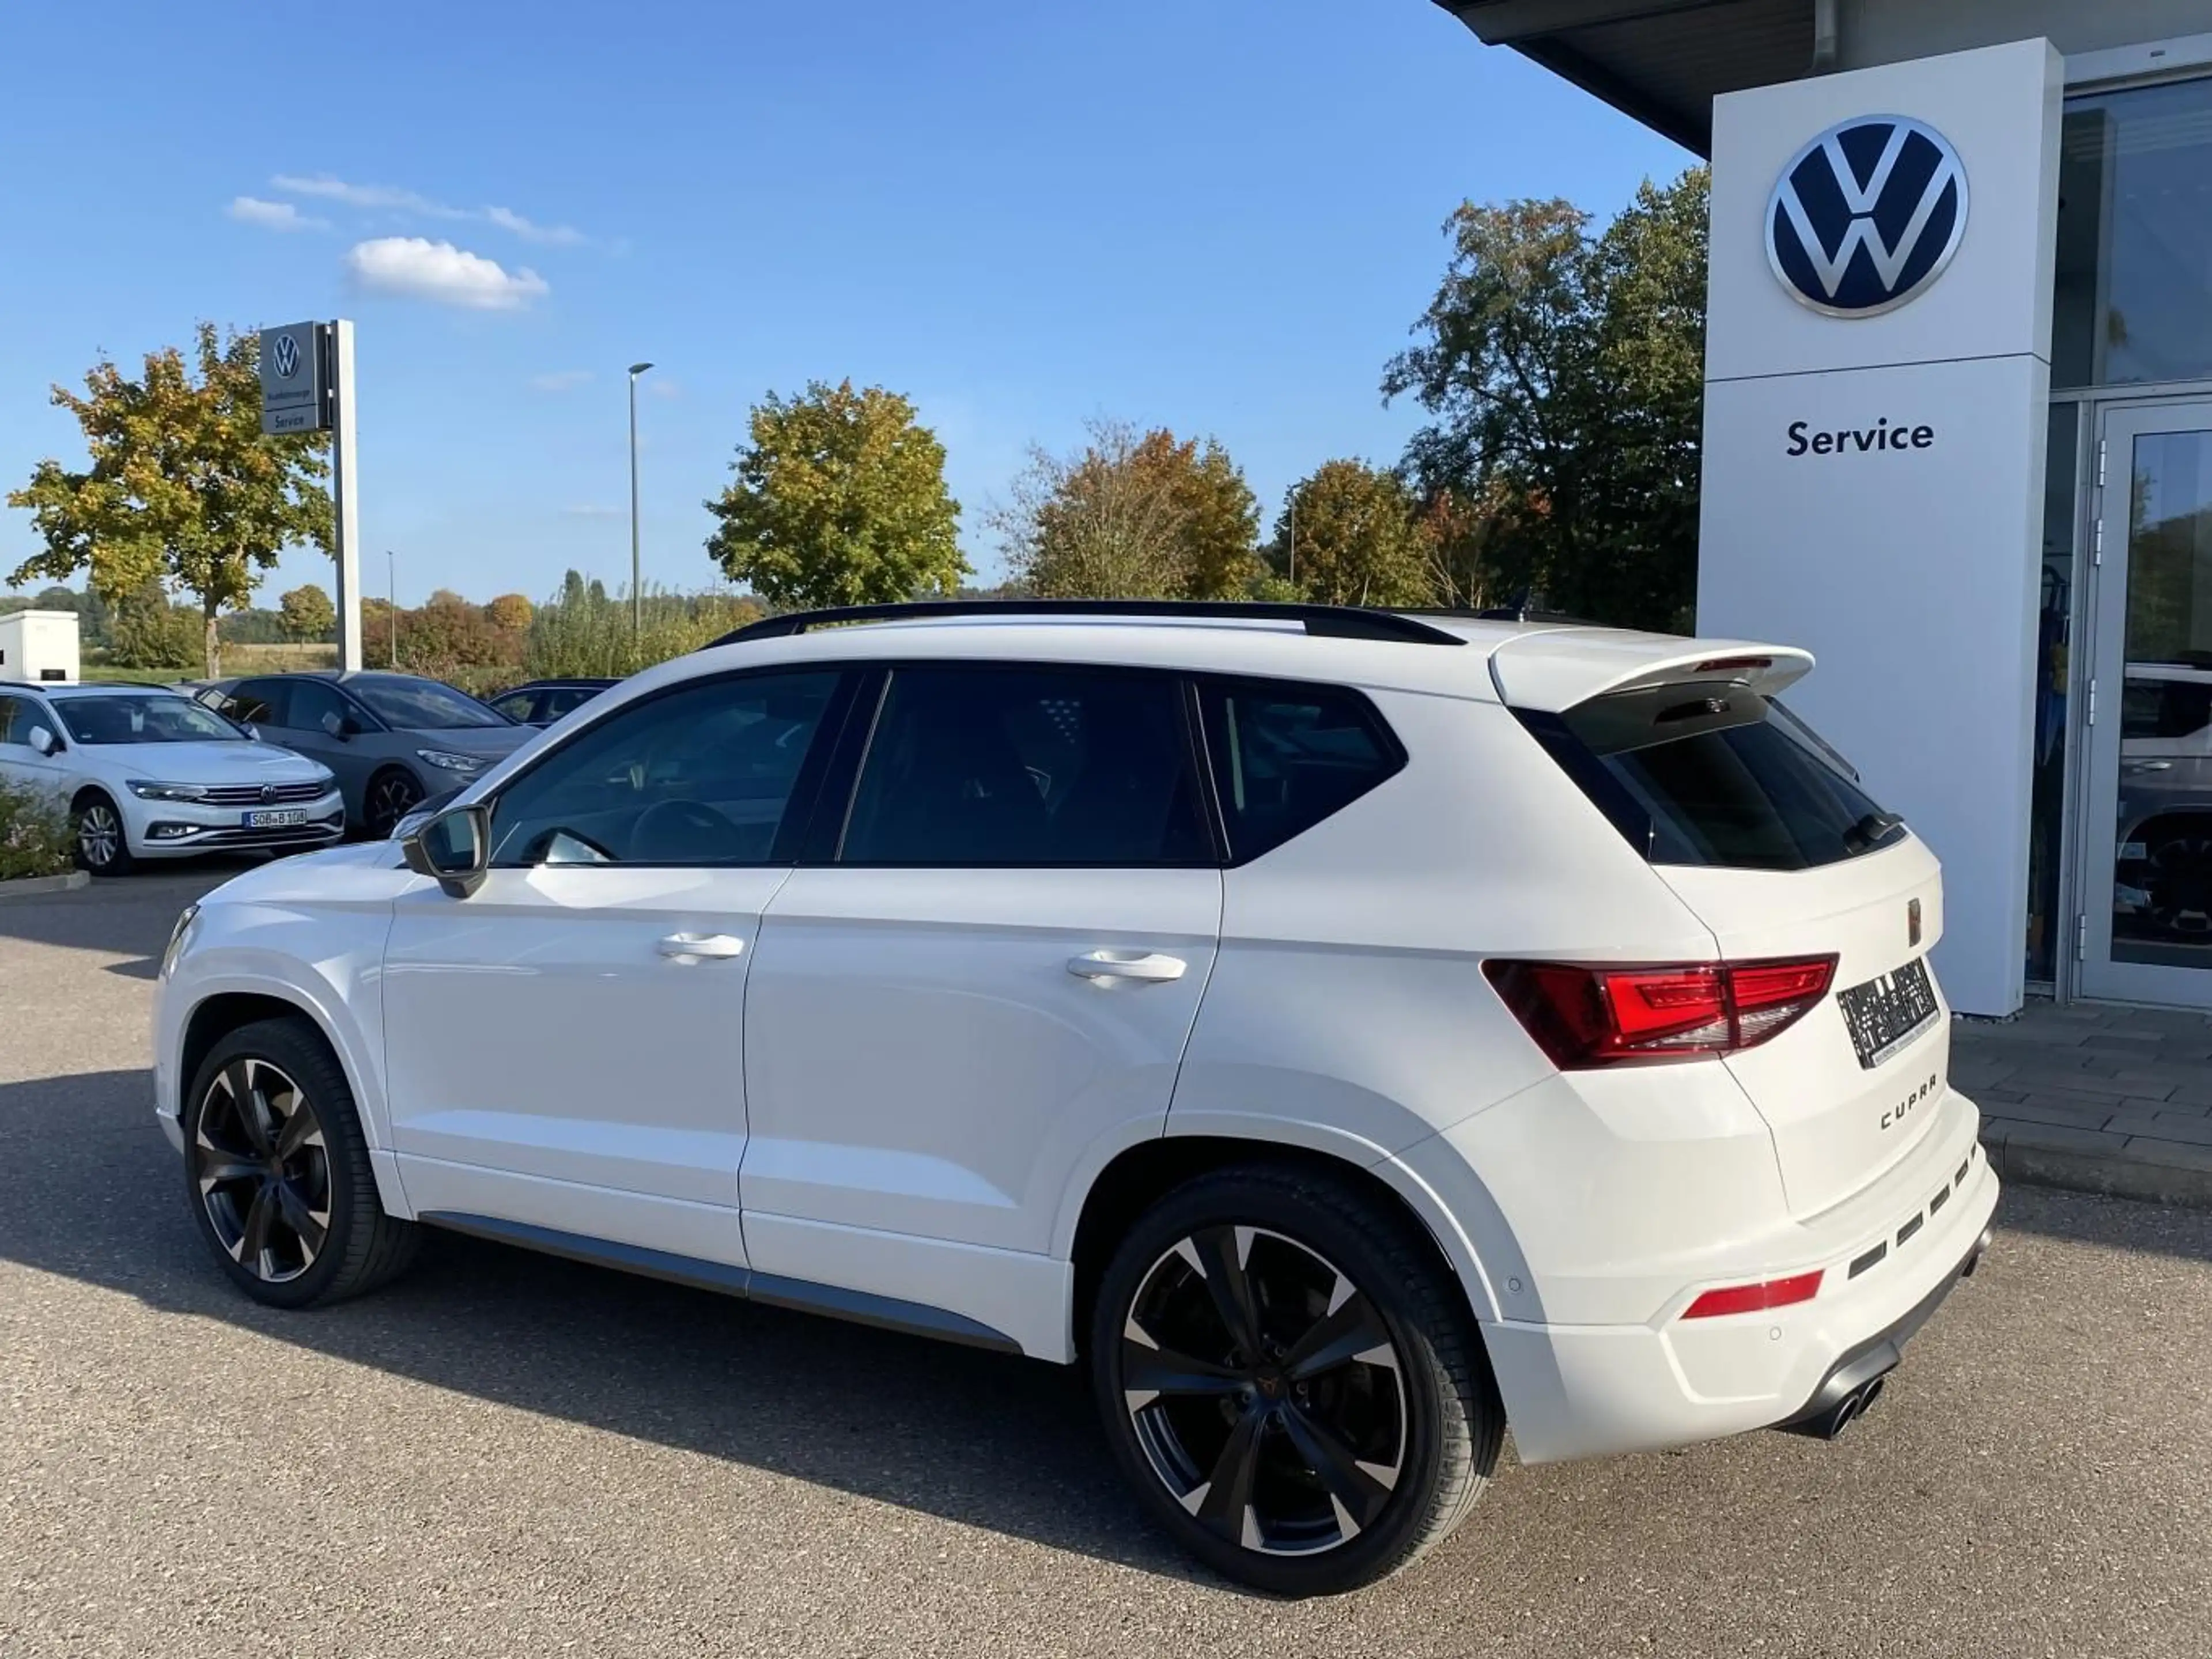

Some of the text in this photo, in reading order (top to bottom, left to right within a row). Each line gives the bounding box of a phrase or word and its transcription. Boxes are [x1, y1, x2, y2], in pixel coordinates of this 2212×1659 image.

[1774, 119, 1960, 301] VW
[274, 335, 298, 378] VW
[275, 414, 304, 429] Service
[1786, 417, 1934, 456] Service
[1881, 1074, 1936, 1130] CUPRA
